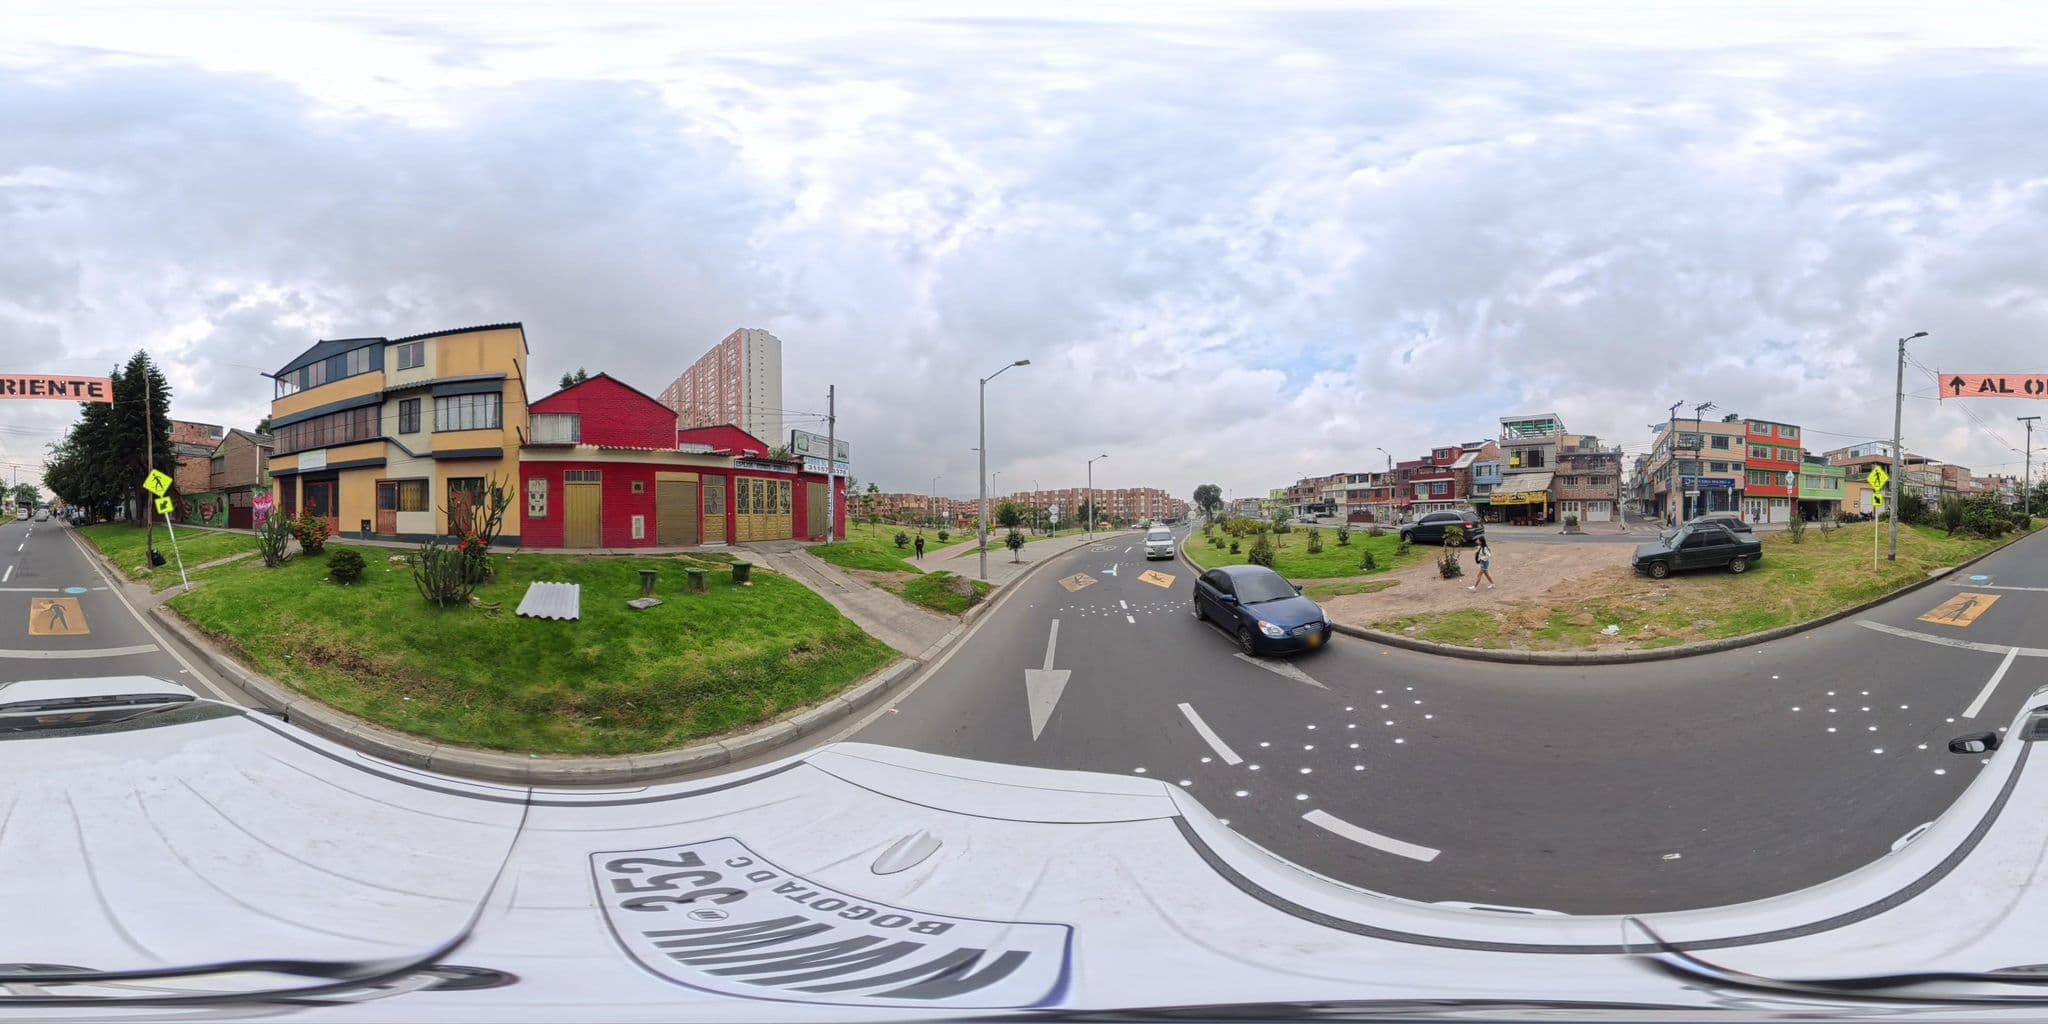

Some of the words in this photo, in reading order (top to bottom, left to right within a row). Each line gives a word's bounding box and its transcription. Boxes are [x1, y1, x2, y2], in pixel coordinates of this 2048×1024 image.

[0, 379, 103, 397] RIENTE
[1977, 378, 2015, 394] AL
[2024, 378, 2048, 395] O
[725, 856, 753, 869] C
[605, 851, 748, 913] 352
[747, 870, 778, 882] D
[773, 881, 954, 936] BOGOTA
[641, 914, 1032, 999] NWW
